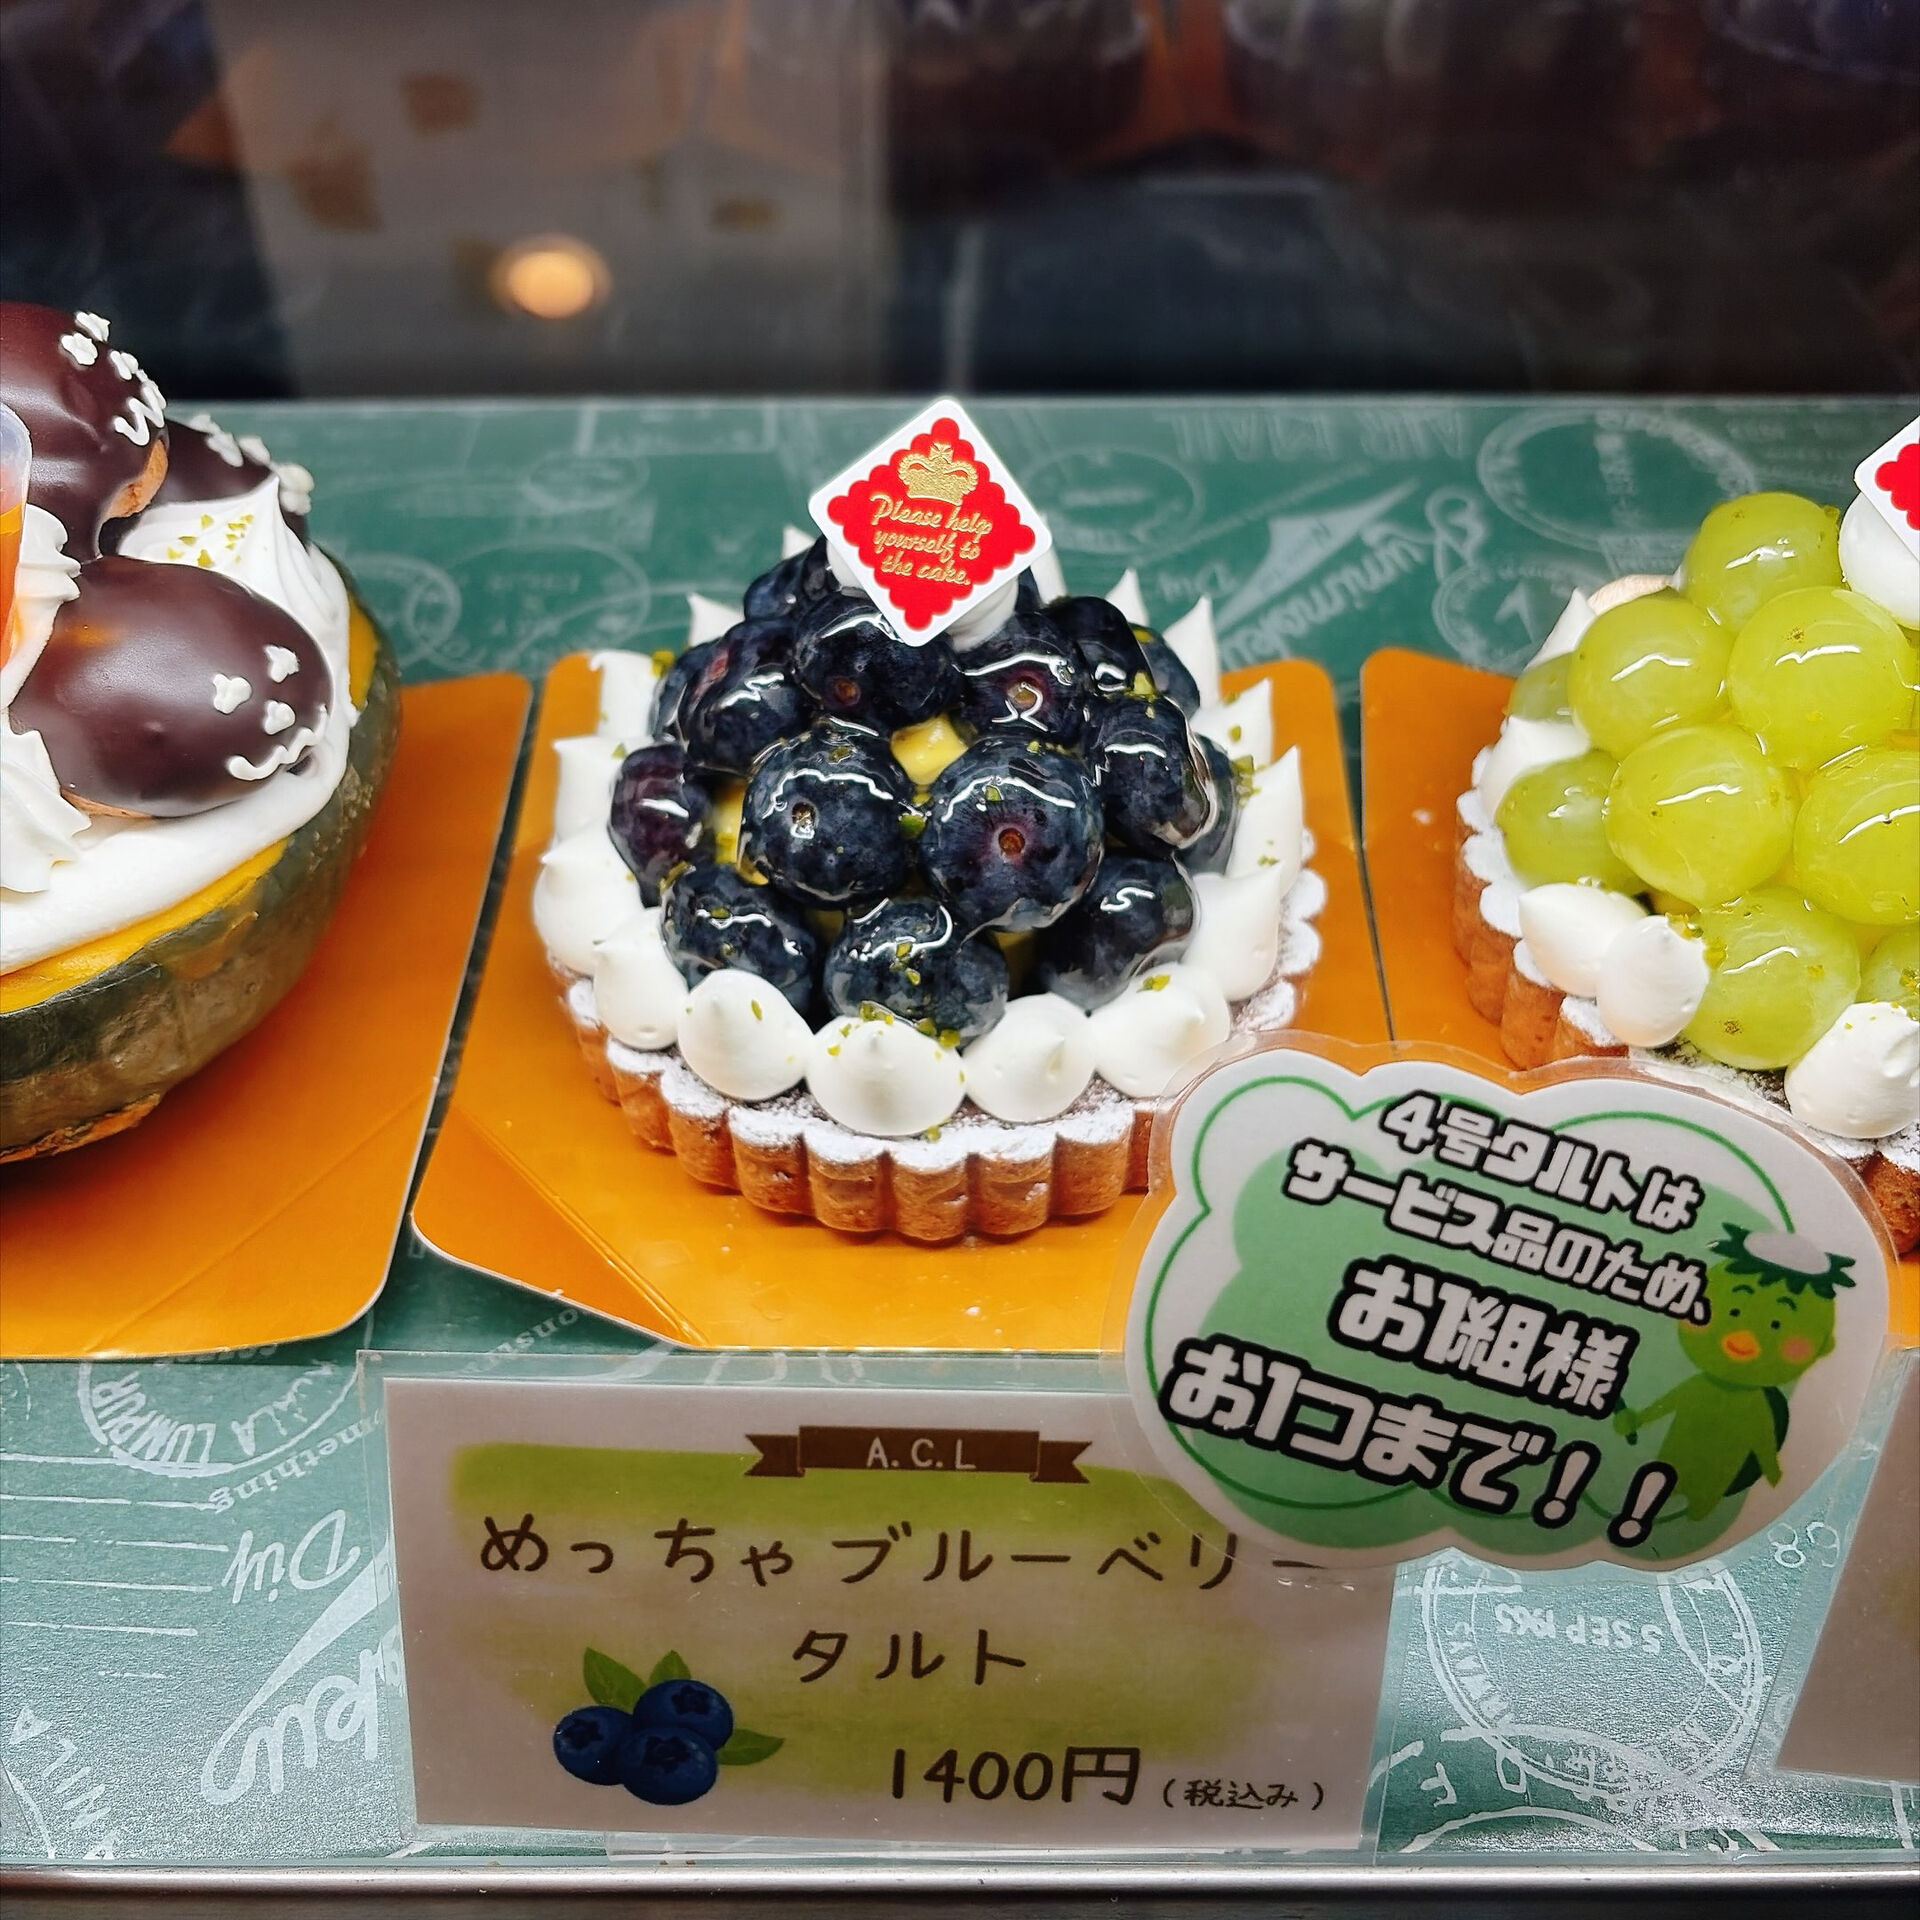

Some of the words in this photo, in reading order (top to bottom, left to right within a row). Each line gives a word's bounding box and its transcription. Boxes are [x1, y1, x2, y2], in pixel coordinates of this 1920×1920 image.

[869, 494, 943, 528] Please
[944, 506, 994, 544] help
[873, 531, 958, 563] yourself
[959, 541, 981, 560] to
[881, 550, 914, 577] the
[916, 560, 971, 586] cake.
[1380, 1089, 1706, 1235] 4号タルトは
[1283, 1137, 1713, 1324] サービス品のため、
[1327, 1254, 1640, 1420] お1組様
[792, 1629, 1027, 1686] タルト
[891, 1746, 1141, 1806] 1400円
[1161, 1778, 1325, 1811] (税込み)
